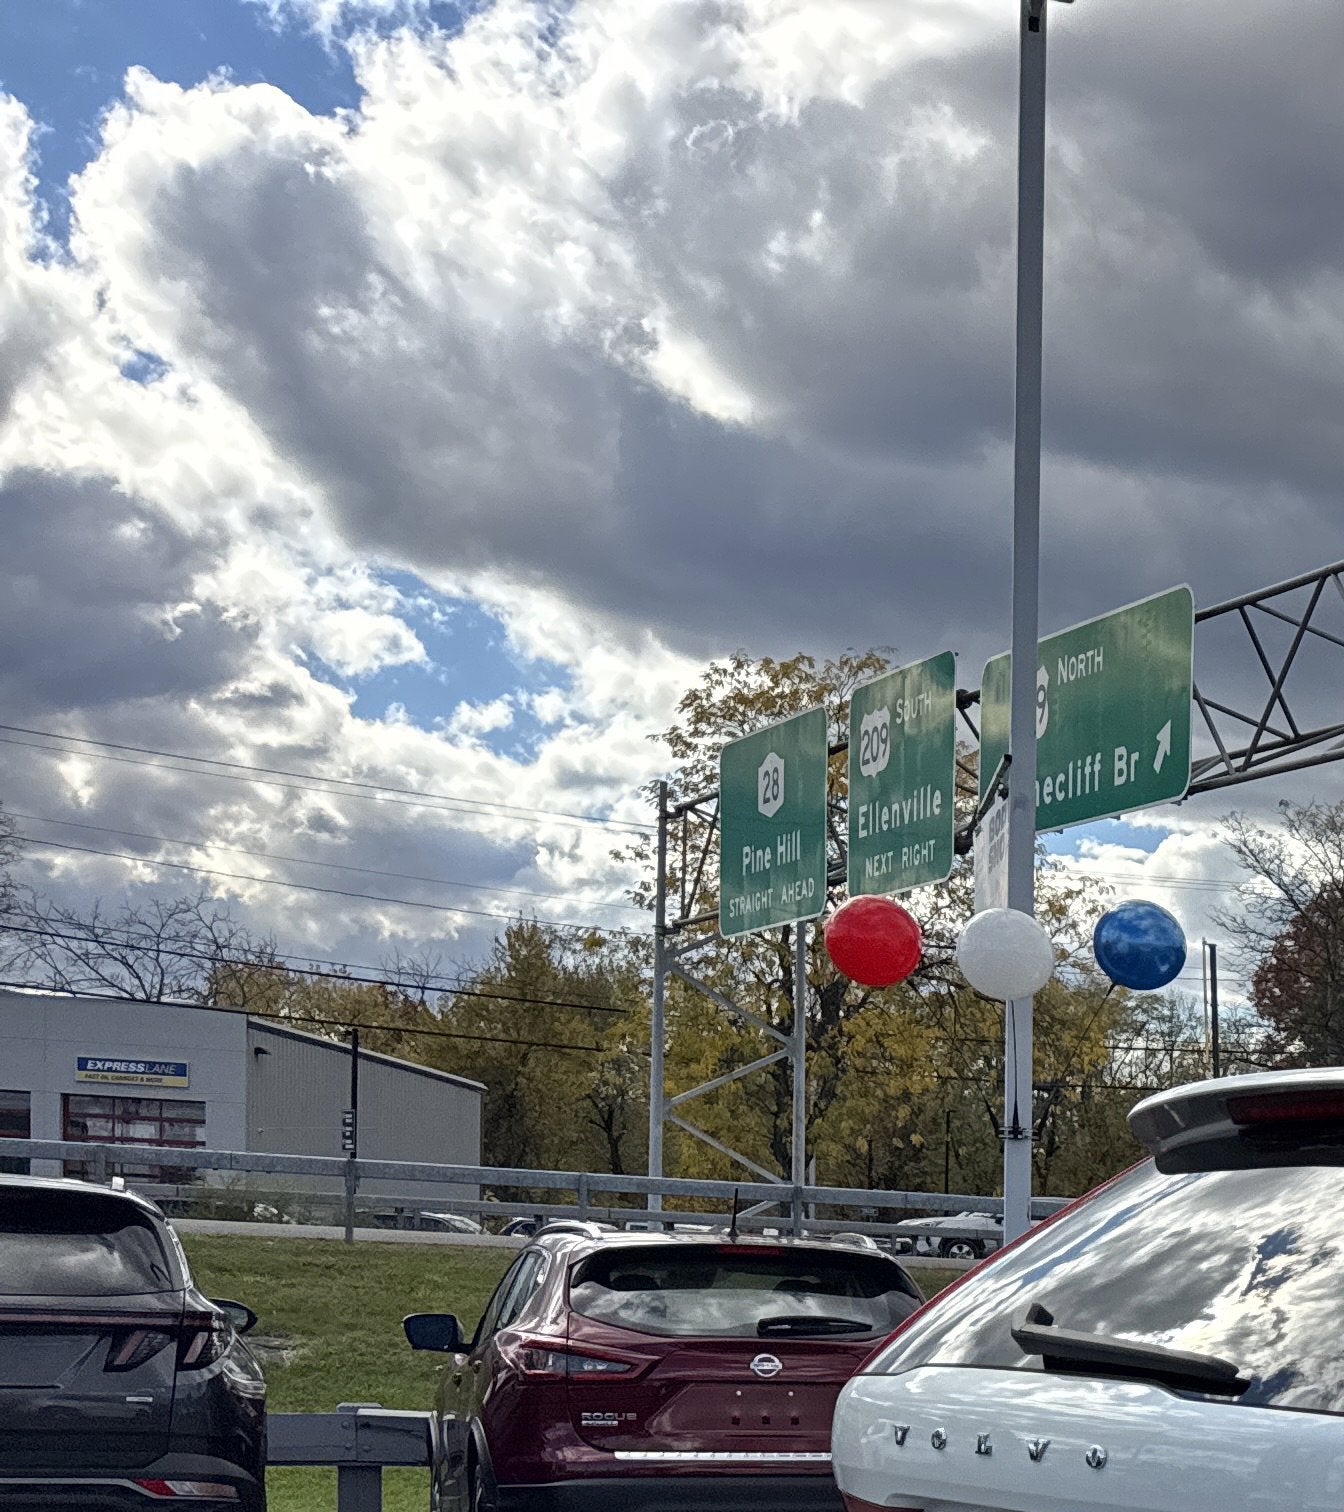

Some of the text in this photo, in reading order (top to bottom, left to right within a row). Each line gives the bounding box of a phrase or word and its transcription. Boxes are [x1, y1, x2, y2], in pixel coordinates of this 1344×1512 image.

[1057, 646, 1104, 686] NORTH
[895, 691, 932, 724] SOUTH
[861, 722, 889, 767] 209
[762, 766, 780, 805] 28
[1114, 745, 1140, 787] Br
[858, 783, 942, 839] Ellenville
[742, 829, 801, 876] Pine Hill
[865, 839, 936, 879] NEXT RIGHT
[729, 877, 815, 919] STRAIGHT AHEAD
[581, 1412, 637, 1421] ROGUE
[893, 1424, 1108, 1470] VOLVO
